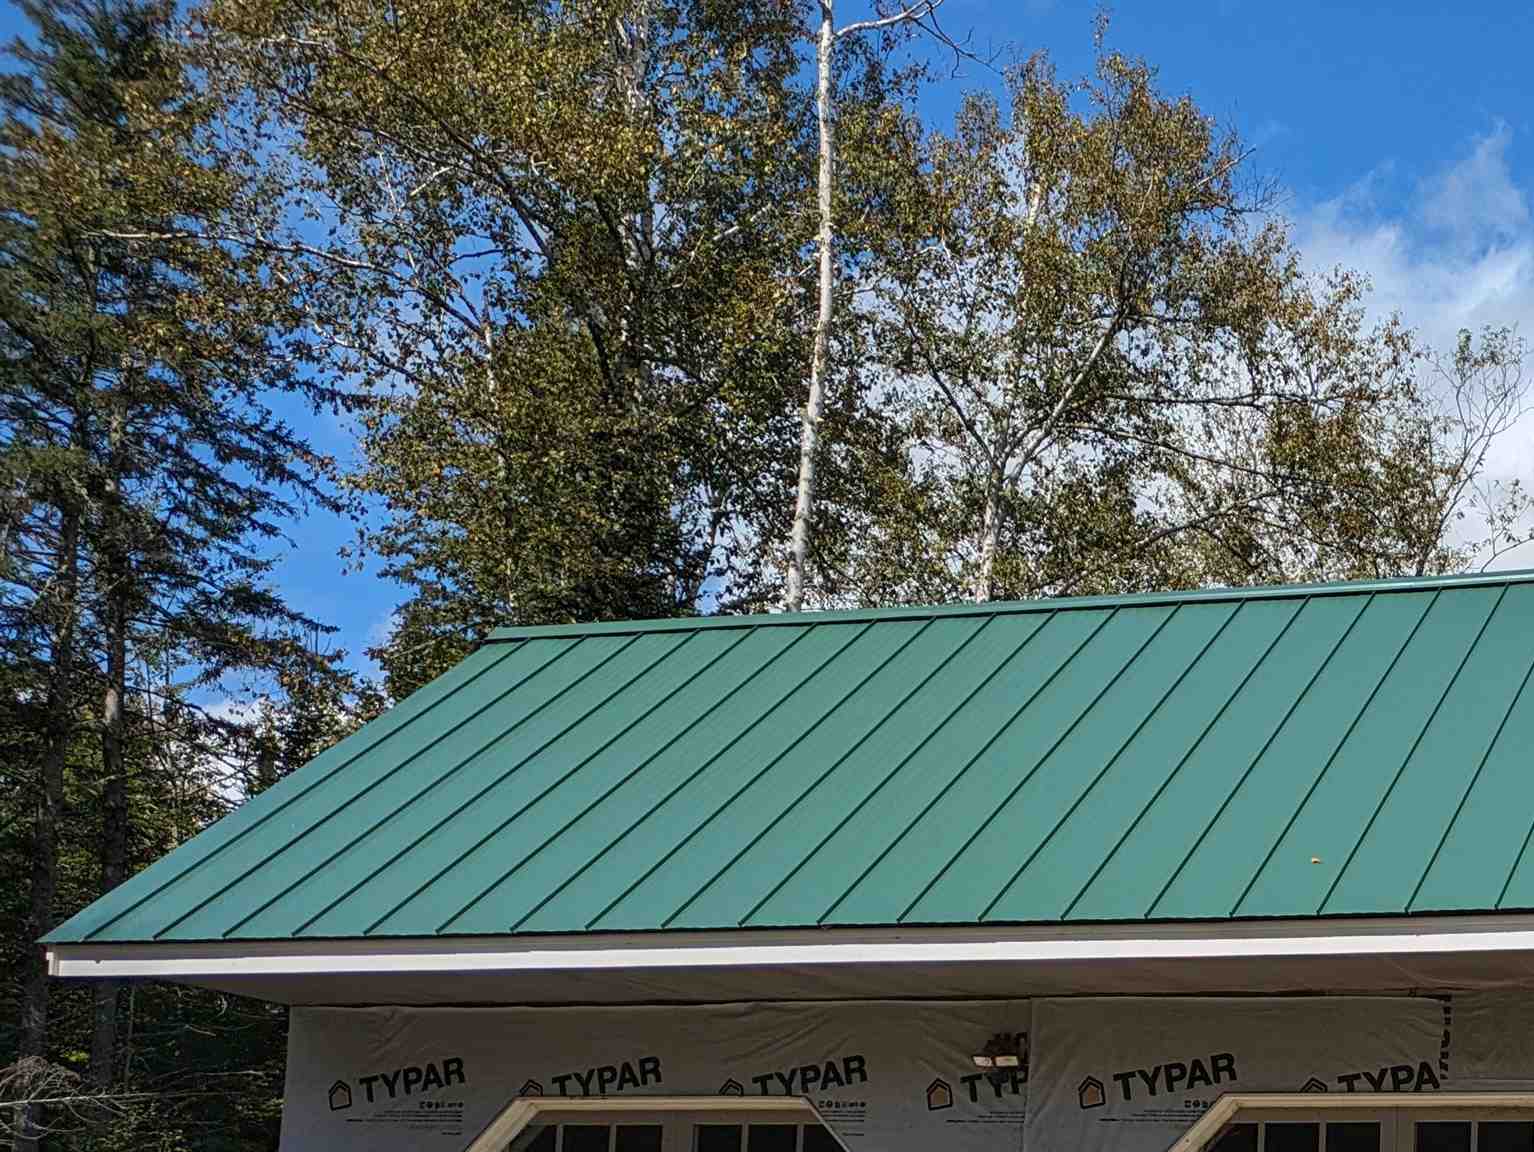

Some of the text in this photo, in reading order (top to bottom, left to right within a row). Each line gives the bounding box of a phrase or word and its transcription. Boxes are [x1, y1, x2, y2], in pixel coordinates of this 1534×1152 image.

[359, 1057, 466, 1103] TYPAR
[551, 1056, 662, 1097] TYPAR
[751, 1054, 868, 1097] TYPAR
[1112, 1053, 1237, 1101] TYPAR
